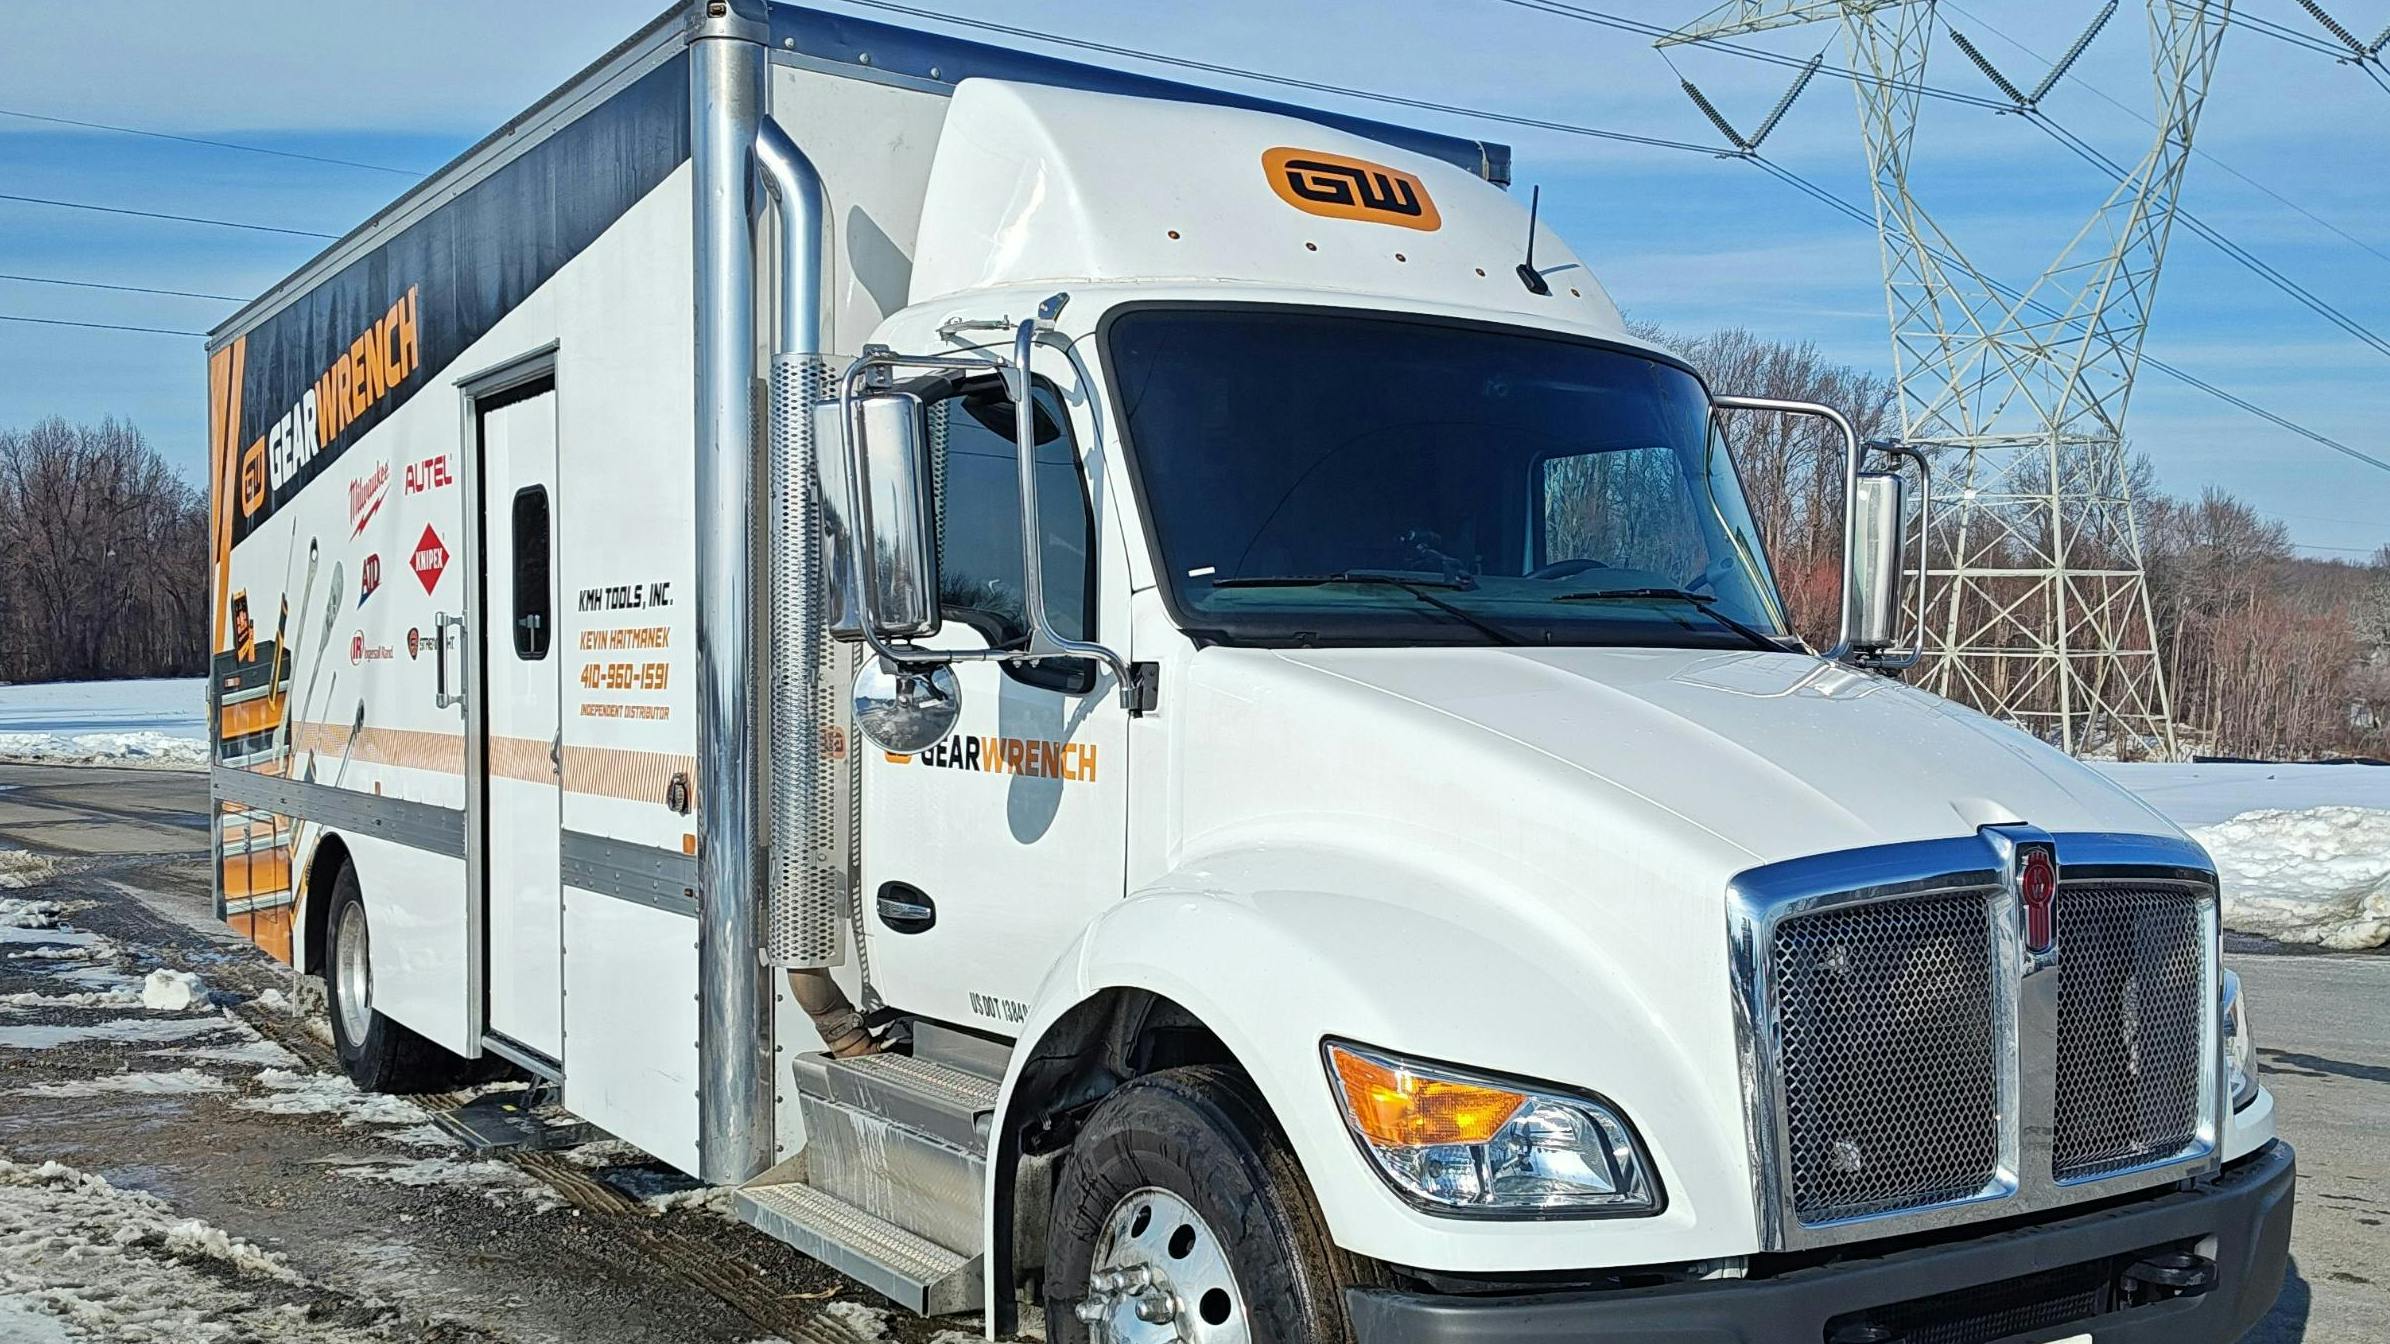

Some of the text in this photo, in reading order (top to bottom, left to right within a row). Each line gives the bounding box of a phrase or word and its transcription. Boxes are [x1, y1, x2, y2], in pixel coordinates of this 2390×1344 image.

[1282, 158, 1424, 218] GW
[268, 286, 419, 491] GEARWRENCH
[404, 454, 452, 495] AUTEL
[348, 459, 389, 525] Milwaukee
[415, 548, 443, 571] KNIPEX
[578, 582, 673, 612] KMH TOOLS, INC.
[352, 636, 363, 660] IR
[579, 630, 609, 650] KEVIN
[580, 662, 670, 689] 410-960-1591
[579, 703, 670, 720] INDEPENDENT DISTRIBUTOR
[969, 992, 1032, 1024] US DOT 1384
